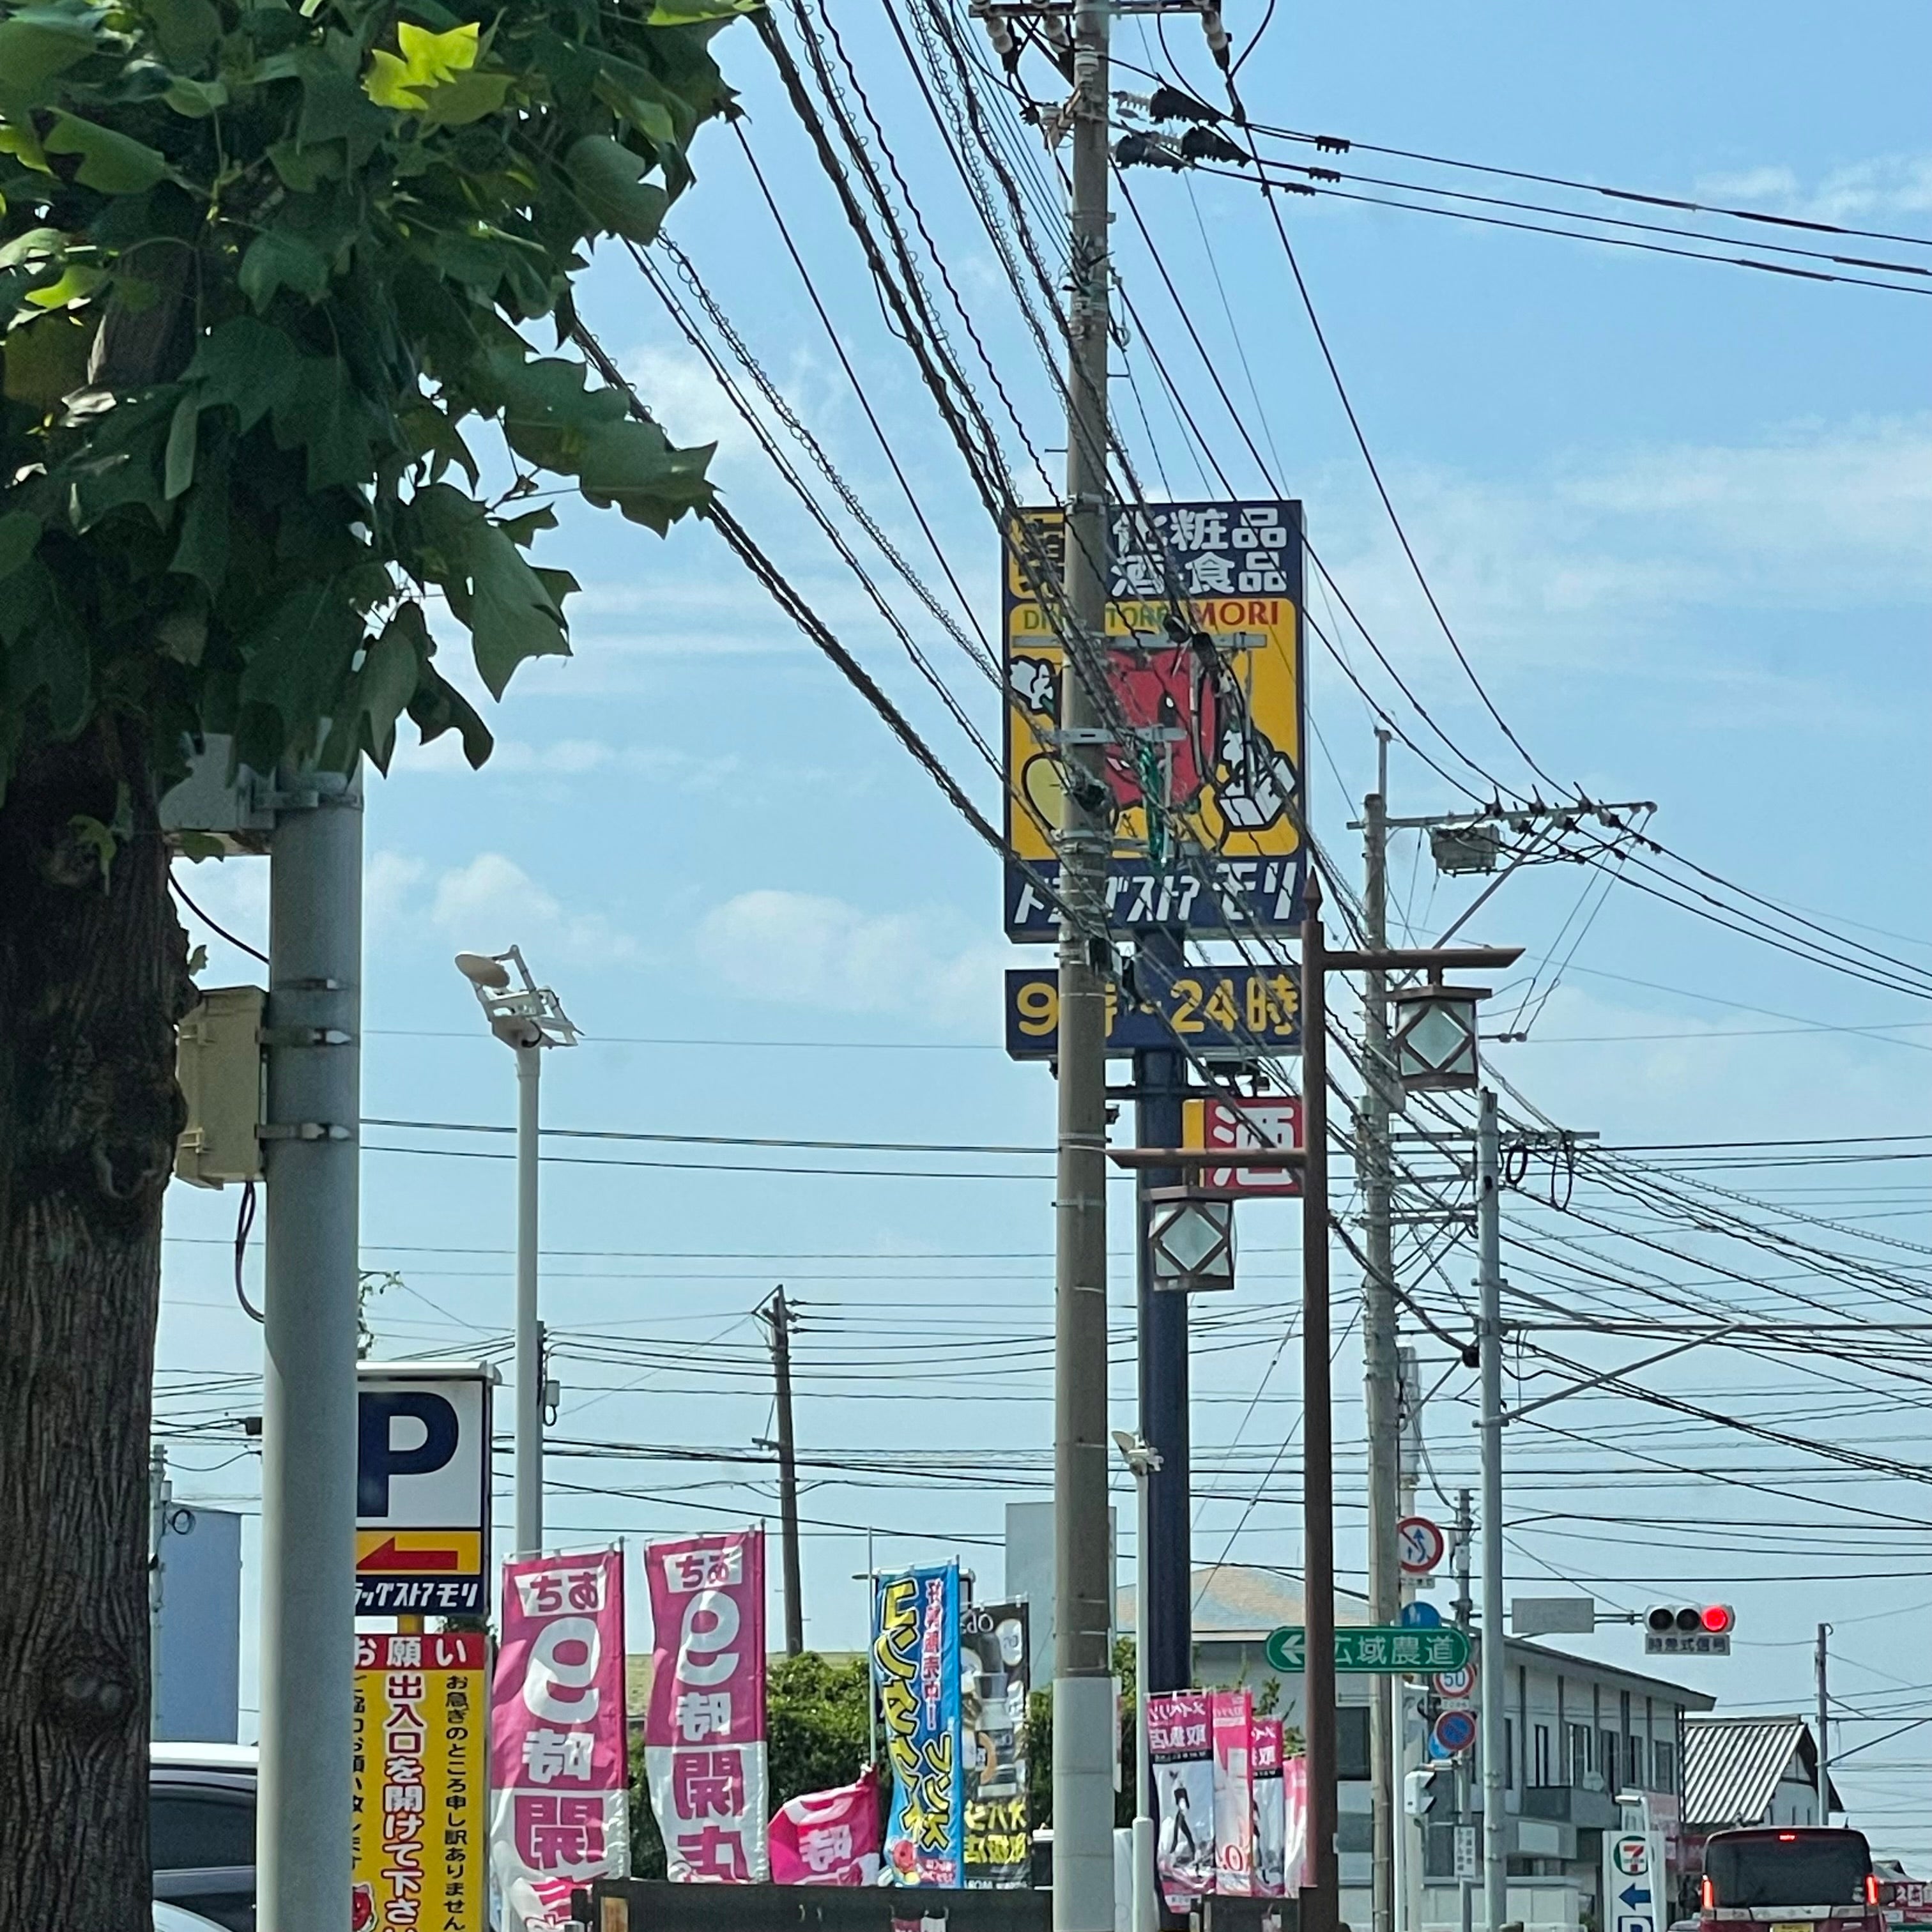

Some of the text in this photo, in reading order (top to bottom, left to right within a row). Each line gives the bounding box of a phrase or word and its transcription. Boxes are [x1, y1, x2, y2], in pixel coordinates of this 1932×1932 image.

[1112, 508, 1287, 553] 化粧品
[356, 1391, 459, 1517] P
[355, 1636, 467, 1667] お願い
[1335, 1635, 1455, 1665] 広域農道
[1444, 1670, 1466, 1687] 50
[381, 1673, 425, 1932] 出入口を開けて下さ
